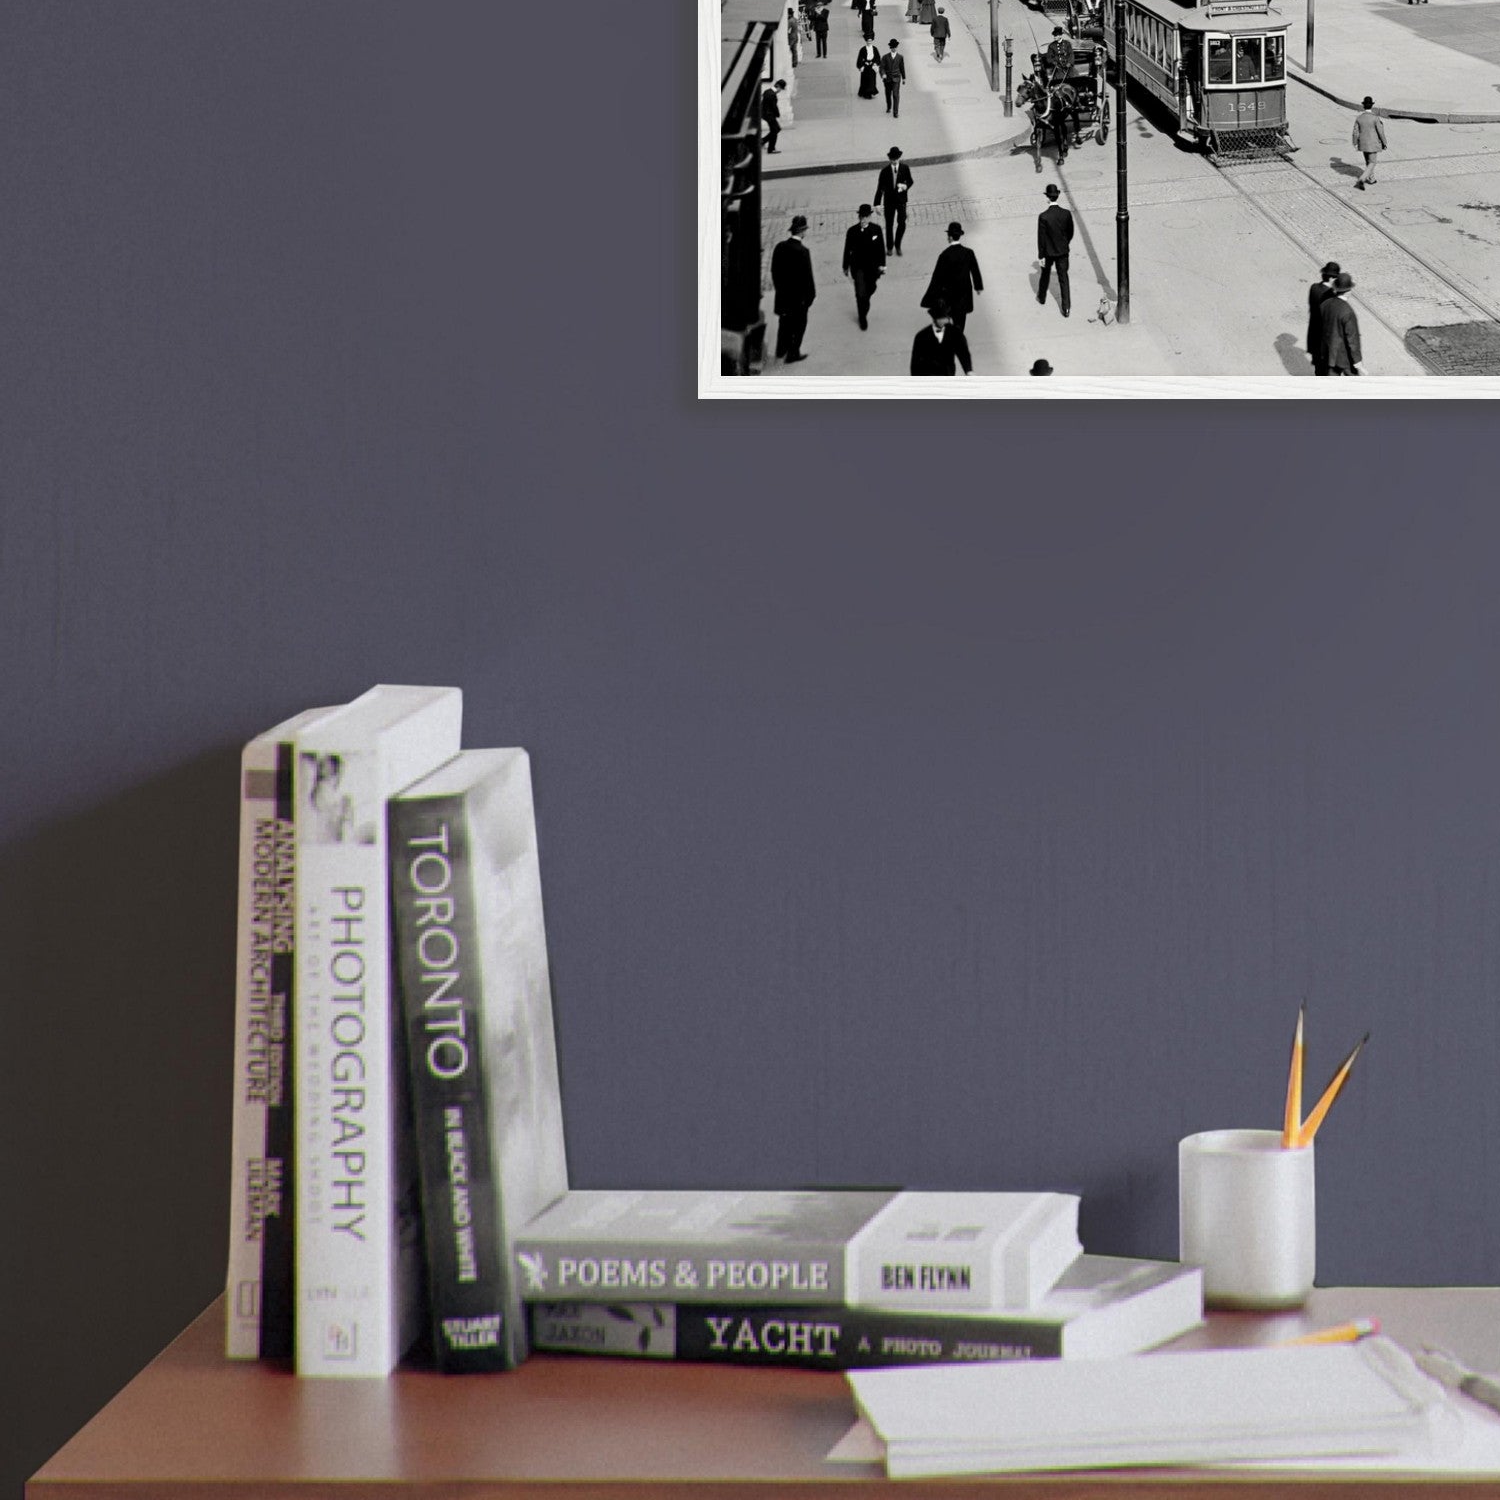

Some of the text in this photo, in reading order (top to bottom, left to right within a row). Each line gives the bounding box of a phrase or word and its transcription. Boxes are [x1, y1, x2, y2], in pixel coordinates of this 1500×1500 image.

[272, 819, 294, 953] ANALYSING
[246, 818, 273, 1104] MODERN ARCHITECTURE
[407, 822, 469, 1079] TORONTO
[331, 886, 366, 1241] PHOTOGRAPHY
[447, 1129, 468, 1185] BLACK
[453, 1186, 471, 1226] AND
[558, 1259, 829, 1290] POEMS & PEOPLE
[881, 1263, 971, 1290] BEN FLYNN
[703, 1316, 841, 1356] YACHT
[857, 1335, 871, 1353] A
[882, 1336, 943, 1357] PHOTO
